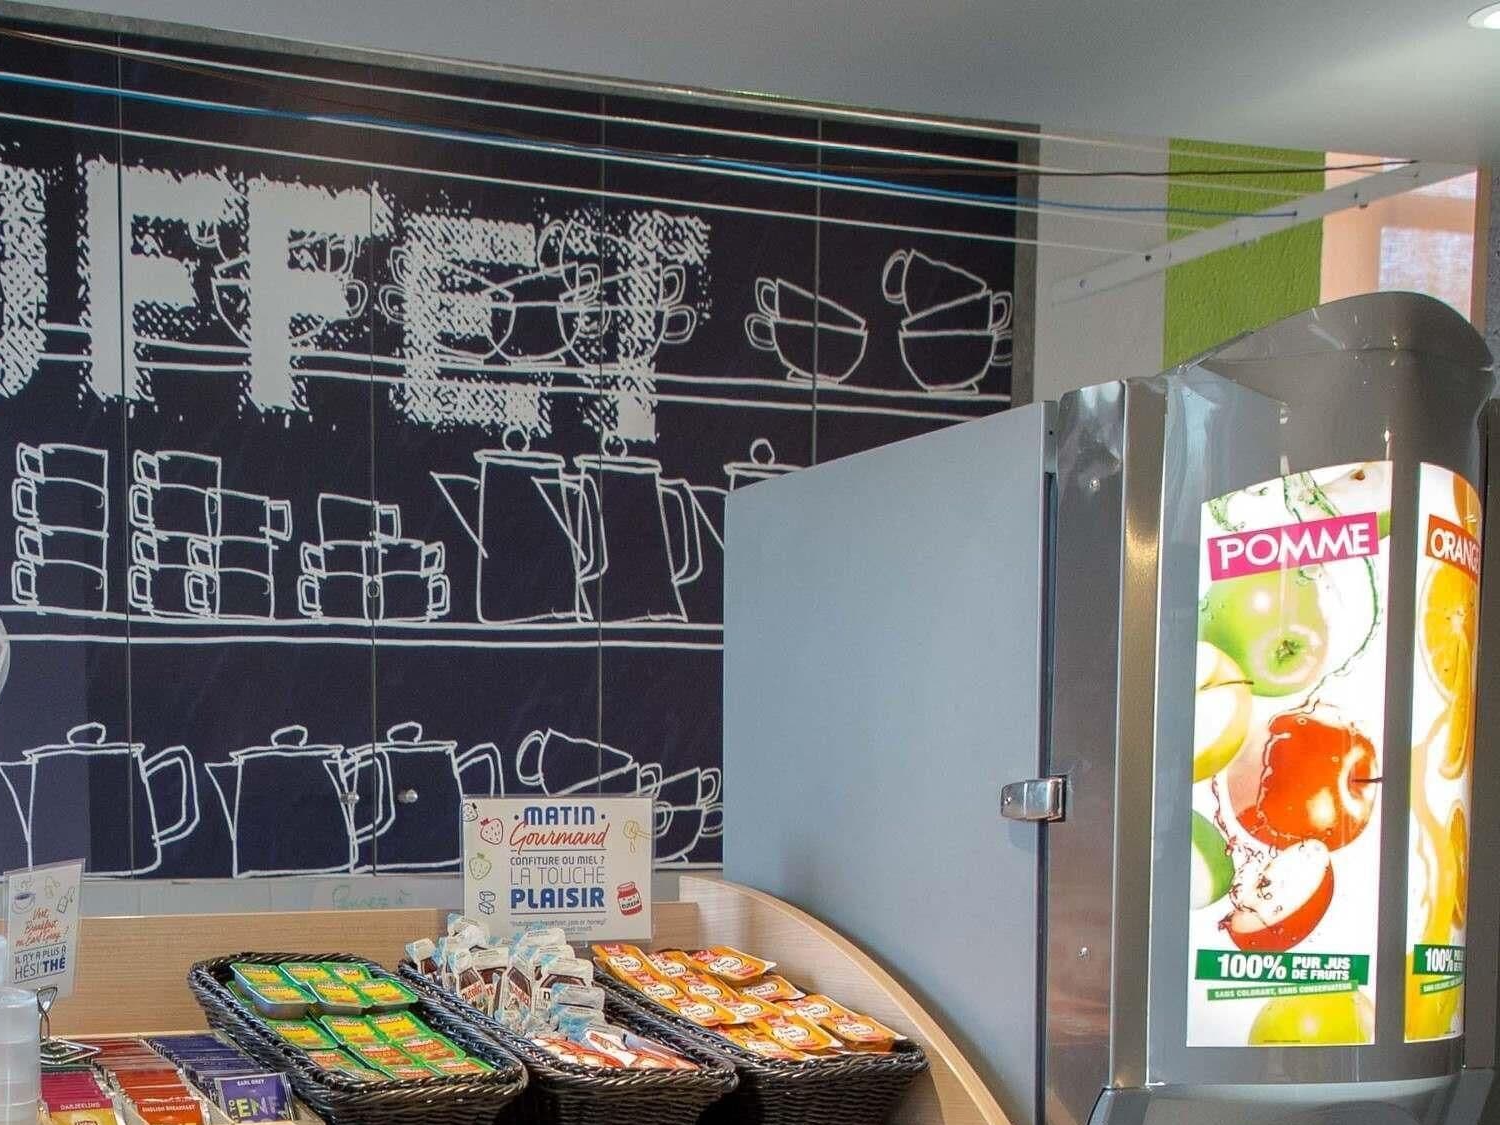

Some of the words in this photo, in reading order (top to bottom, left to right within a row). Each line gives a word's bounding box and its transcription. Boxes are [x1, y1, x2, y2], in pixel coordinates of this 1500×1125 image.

[1217, 523, 1370, 571] POMME
[1431, 528, 1481, 576] ORANG
[523, 806, 596, 826] MATIN
[509, 822, 611, 855] Gourmand
[510, 856, 560, 866] CONFITURE
[562, 856, 575, 865] OU
[576, 856, 598, 865] MIEL
[511, 867, 531, 885] LA
[537, 866, 605, 884] TOUCHE
[510, 887, 605, 909] PLAISIR
[1217, 953, 1287, 980] 100%
[1292, 956, 1322, 970] PUR
[1323, 957, 1351, 970] JUS
[1425, 947, 1454, 972] 100%
[1291, 969, 1308, 980] DE
[1309, 970, 1350, 981] FRUITS
